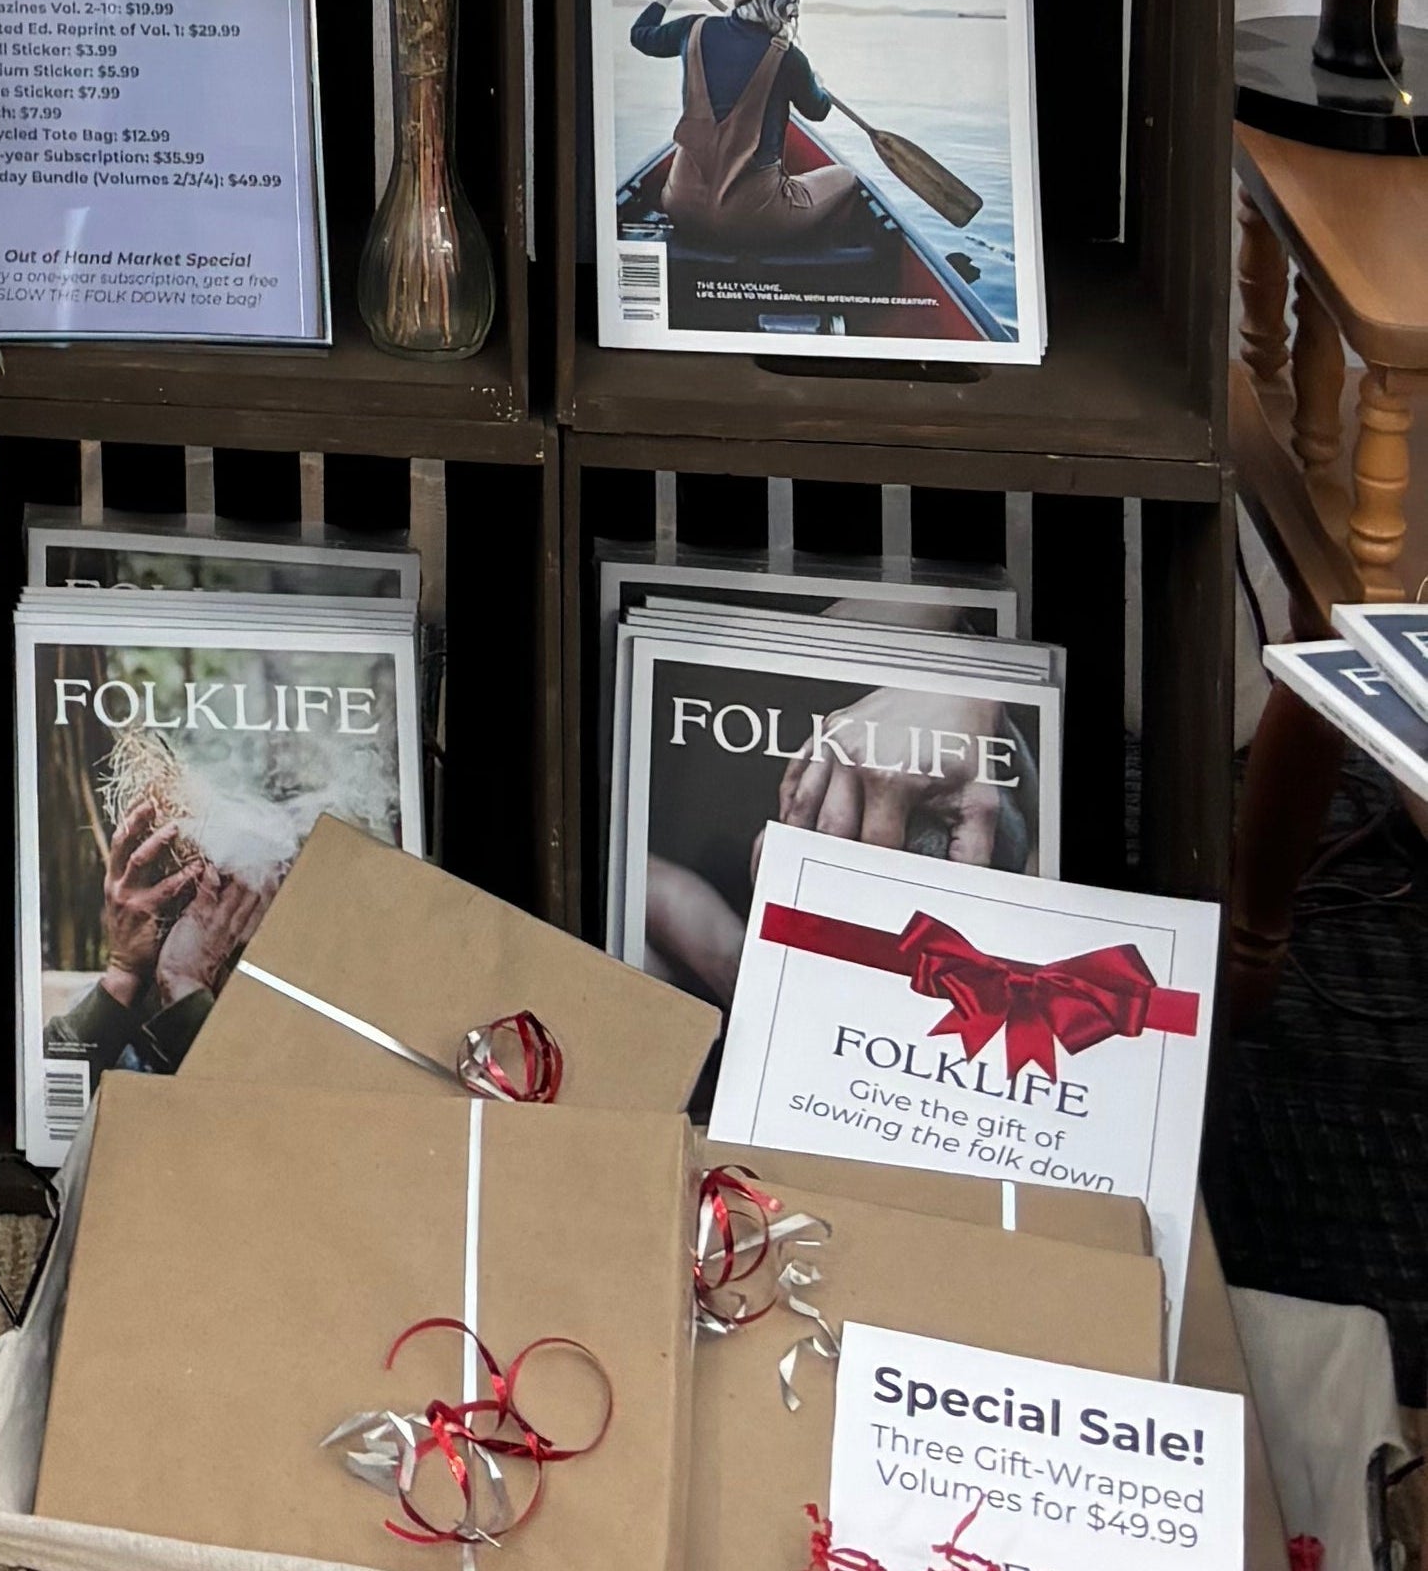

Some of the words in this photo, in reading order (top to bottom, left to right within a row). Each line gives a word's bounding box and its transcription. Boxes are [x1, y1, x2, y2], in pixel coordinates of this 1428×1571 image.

[50, 2, 81, 15] Vol.
[84, 2, 121, 15] 2-10:
[125, 2, 174, 16] $19.99
[28, 23, 53, 35] Ed.
[56, 23, 116, 41] Reprint
[120, 23, 137, 36] of
[140, 23, 171, 37] Vol.
[174, 24, 184, 37] 1:
[188, 24, 241, 38] $29.99
[11, 43, 72, 57] Sticker:
[75, 43, 117, 58] $3.99
[33, 63, 94, 78] Sticker:
[97, 64, 139, 79] $5.99
[14, 85, 74, 99] Sticker:
[78, 85, 120, 100] $7.99
[20, 107, 62, 120] $7.99
[43, 128, 77, 142] Tote
[83, 129, 119, 145] Bag:
[122, 129, 170, 143] $12.99
[43, 149, 150, 167] Subscription:
[152, 150, 205, 165] $35.99
[32, 170, 89, 184] Bundle
[93, 171, 169, 187] (Volumes
[173, 172, 224, 189] 2/3/4):
[228, 173, 282, 188] $49.99
[4, 249, 37, 263] Out
[41, 249, 61, 264] of
[65, 250, 112, 265] Hand
[117, 251, 181, 266] Market
[186, 252, 252, 269] Special
[13, 272, 23, 282] a
[27, 272, 96, 287] one-year
[100, 271, 199, 288] subscription,
[203, 274, 230, 289] get
[232, 276, 244, 287] a
[247, 274, 279, 288] free
[696, 281, 714, 290] THE
[49, 289, 81, 302] THE
[84, 289, 127, 303] FOLK
[131, 290, 186, 304] DOWN
[190, 292, 222, 305] tote
[54, 678, 380, 735] FOLKLIFE
[668, 696, 1021, 789] FOLKLIFE
[832, 1025, 1090, 1118] FOLKLIFE
[849, 1079, 912, 1112] Give
[920, 1098, 969, 1126] the
[976, 1114, 1027, 1143] gift
[1034, 1130, 1066, 1151] of
[789, 1093, 903, 1141] slowing
[911, 1125, 961, 1153] the
[967, 1138, 1024, 1170] folk
[1029, 1157, 1115, 1193] down
[873, 1366, 1061, 1438] Special
[1079, 1407, 1206, 1466] Sale!
[870, 1423, 964, 1464] Three
[973, 1445, 1204, 1515] Gift-Wrapped
[876, 1460, 1022, 1514] Volumes
[1031, 1492, 1075, 1524] for
[1086, 1500, 1199, 1549] $49.99
